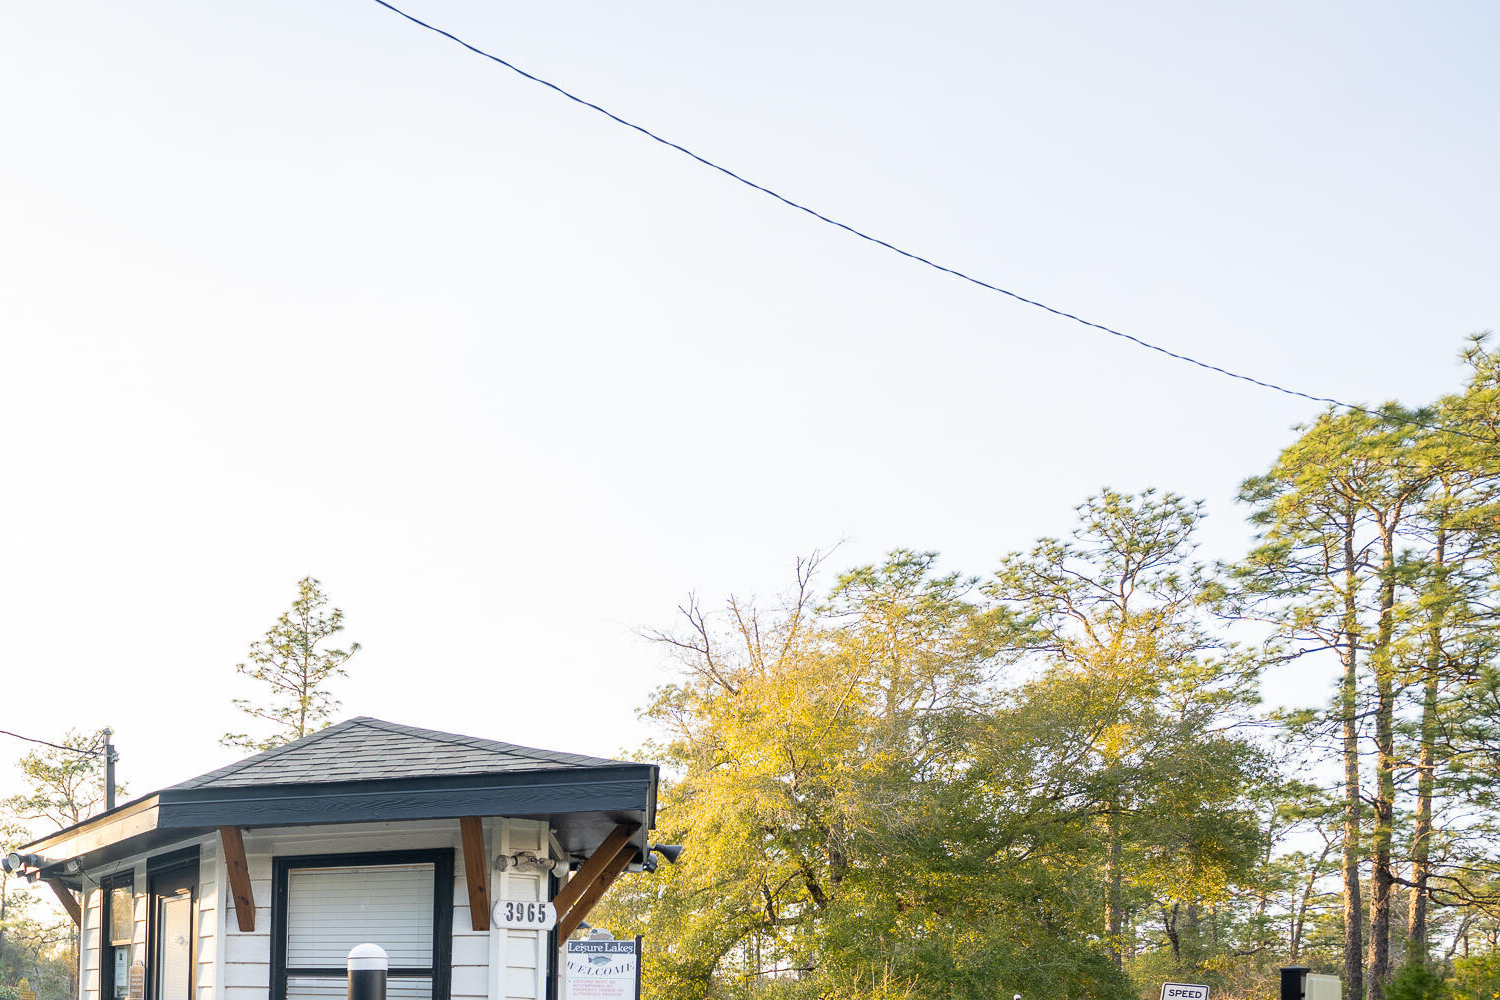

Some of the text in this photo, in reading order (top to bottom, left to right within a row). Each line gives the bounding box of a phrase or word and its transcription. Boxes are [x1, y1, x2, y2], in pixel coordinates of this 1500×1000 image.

[506, 902, 546, 923] 3965
[568, 942, 633, 954] Leisure Lakes
[566, 961, 635, 975] WELCOME
[1168, 989, 1202, 999] SPEED
